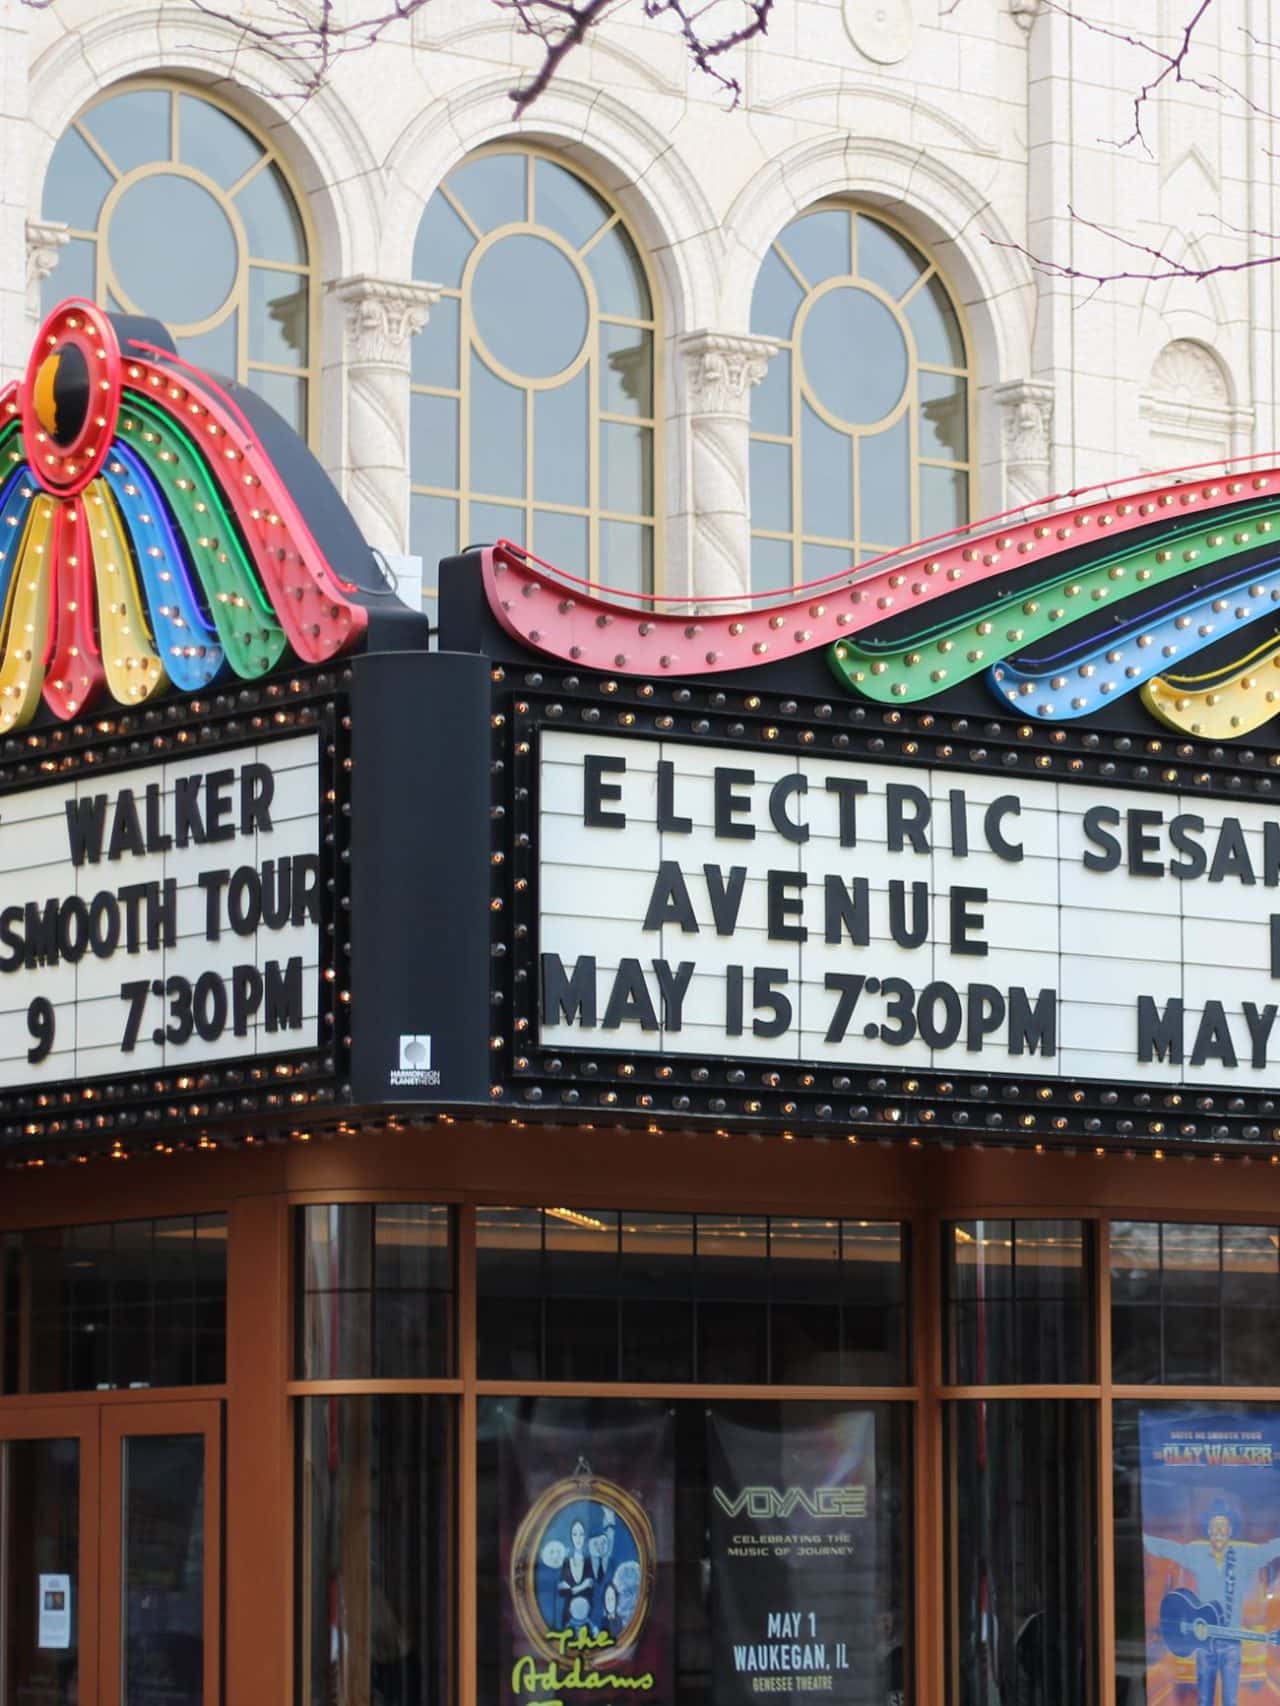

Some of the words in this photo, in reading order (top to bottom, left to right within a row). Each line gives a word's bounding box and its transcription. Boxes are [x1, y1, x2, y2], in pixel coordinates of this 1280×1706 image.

[65, 763, 274, 866] WALKER
[583, 754, 1024, 862] ELECTRIC
[0, 878, 177, 973] SMOOTH
[198, 853, 320, 942] TOUR
[642, 860, 989, 957] AVENUE
[27, 996, 55, 1064] 9
[120, 956, 303, 1052] 7:30PM
[542, 952, 696, 1033] MAY
[726, 964, 793, 1038] 15
[823, 972, 1057, 1057] 7:30PM
[1138, 995, 1279, 1069] MAY
[1163, 1446, 1202, 1464] CLAY
[1204, 1444, 1272, 1465] WALKER
[712, 1485, 867, 1518] VOYAGE
[727, 1547, 769, 1558] MUSIC
[774, 1546, 791, 1557] OF
[796, 1545, 854, 1557] JOURNEY
[732, 1534, 822, 1545] CELEBRATING
[828, 1532, 851, 1544] THE
[546, 1625, 614, 1654] The
[767, 1612, 802, 1638] MAY
[808, 1612, 816, 1637] 1
[836, 1643, 849, 1669] IL
[512, 1656, 654, 1694] Addams
[752, 1677, 793, 1692] GENESEE
[796, 1675, 833, 1691] THEATRE
